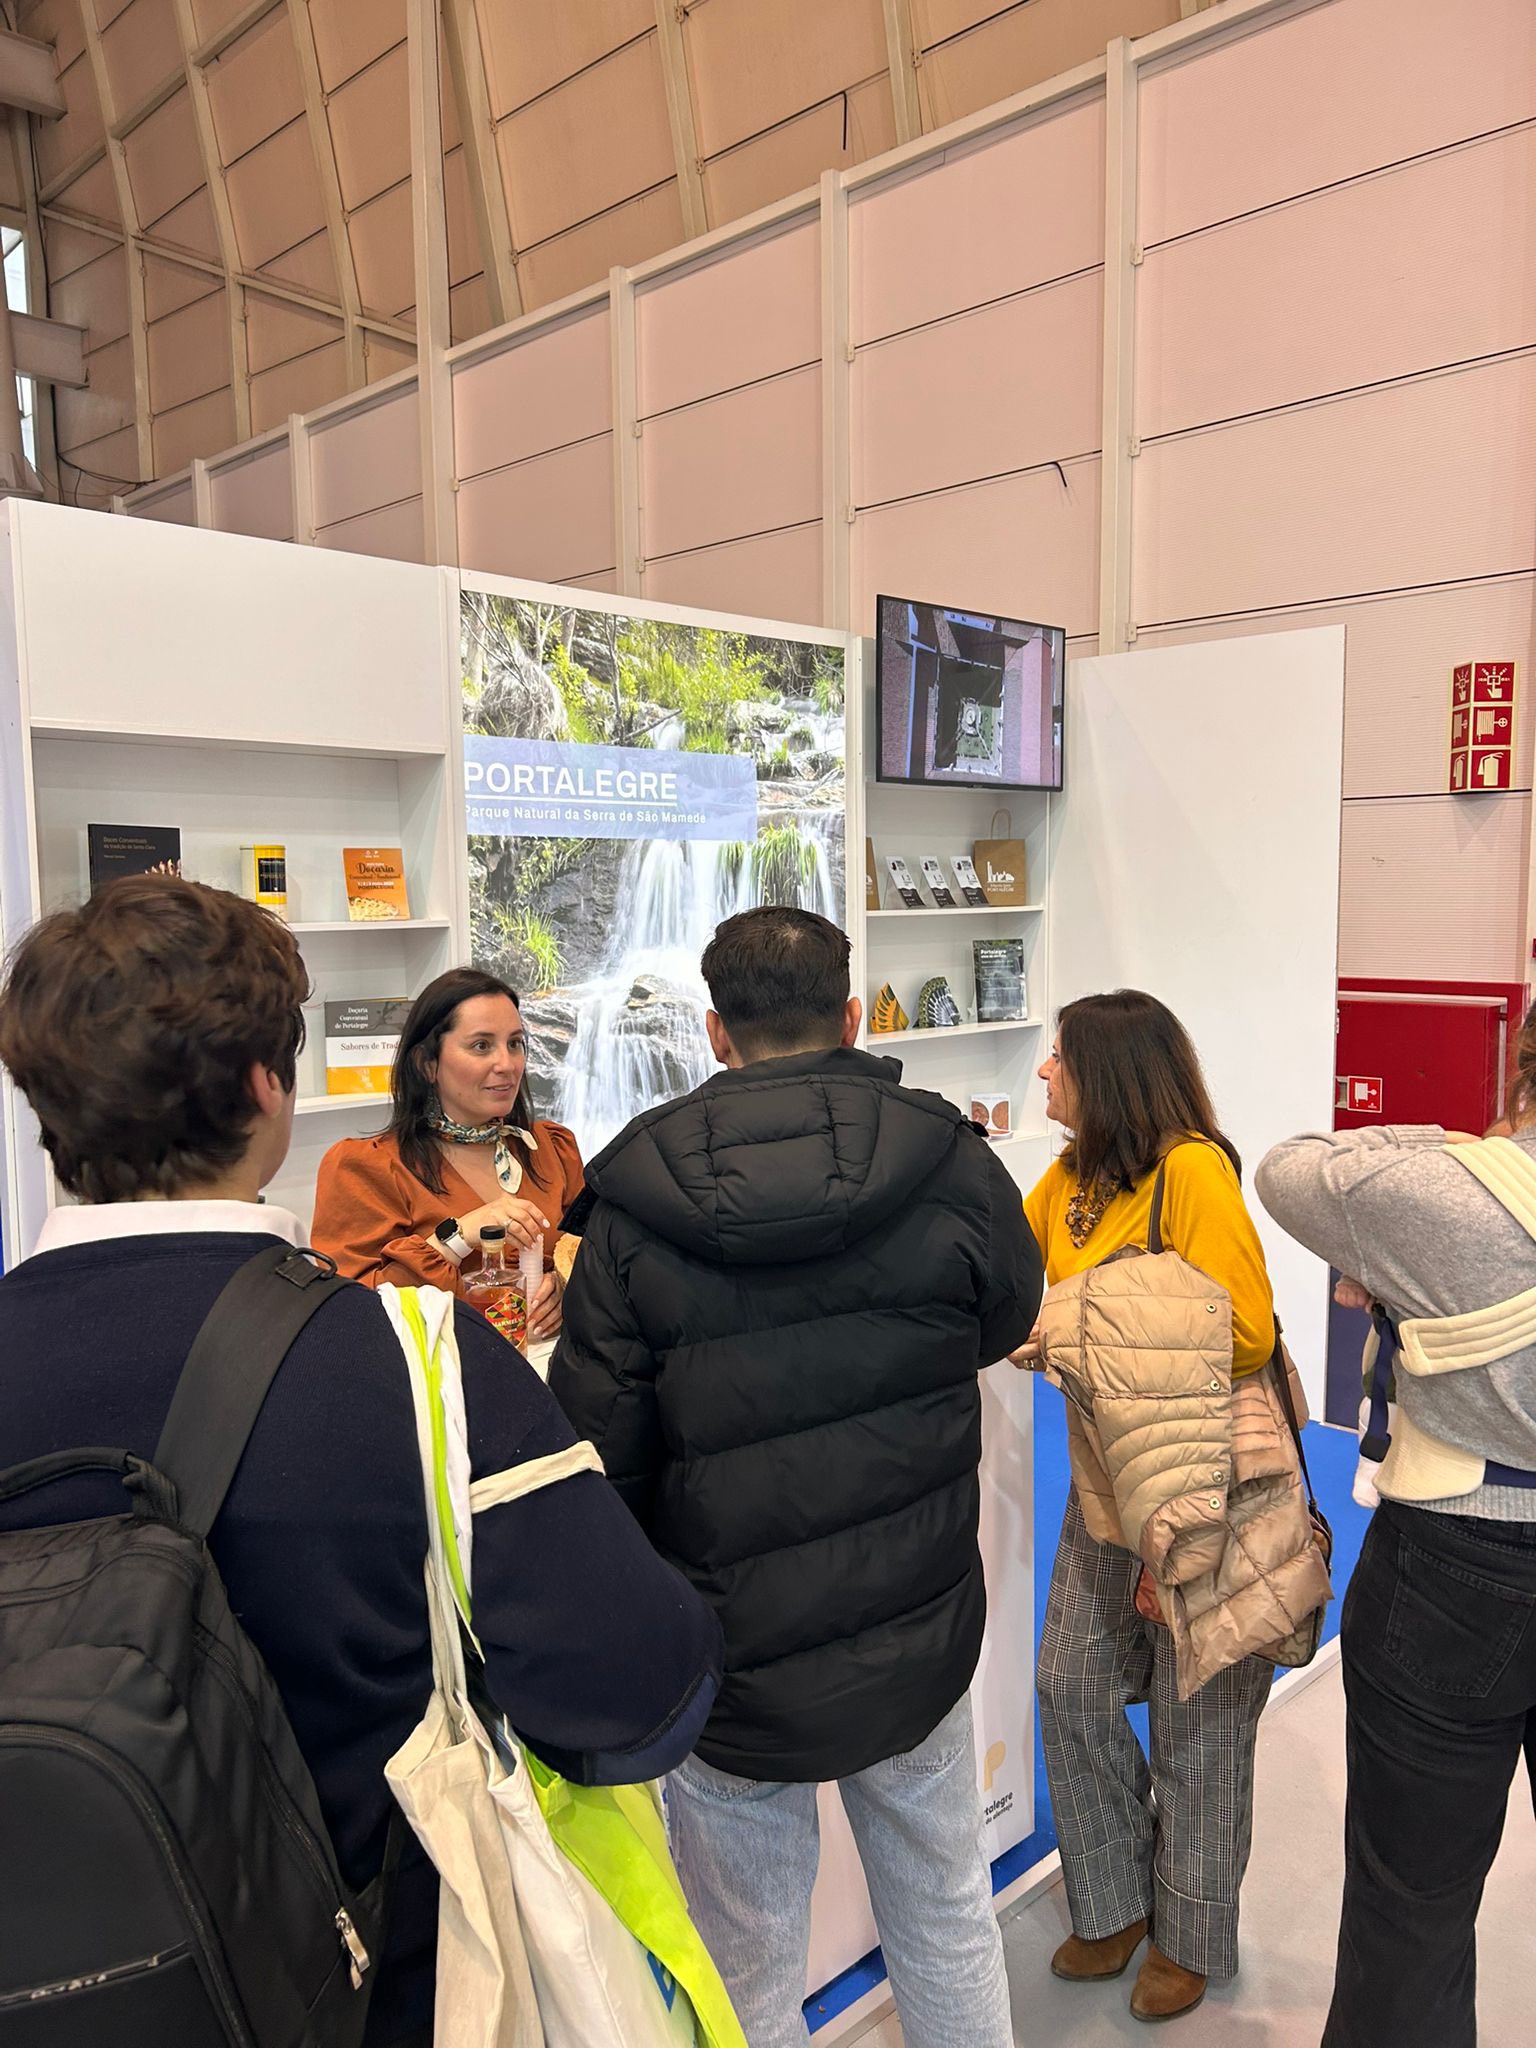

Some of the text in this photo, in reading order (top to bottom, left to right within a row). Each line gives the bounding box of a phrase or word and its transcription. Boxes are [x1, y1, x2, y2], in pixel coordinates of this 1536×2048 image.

[464, 761, 678, 799] PORTALEGRE
[514, 806, 561, 821] Natural
[565, 809, 580, 821] da
[583, 809, 616, 822] Serra
[619, 810, 633, 822] de
[636, 810, 658, 823] São
[662, 812, 706, 824] Mamede
[355, 862, 394, 874] Doçaria
[342, 1022, 369, 1030] Portalegre
[340, 1041, 399, 1051] Sabores de Trad
[984, 1791, 1013, 1816] talegre
